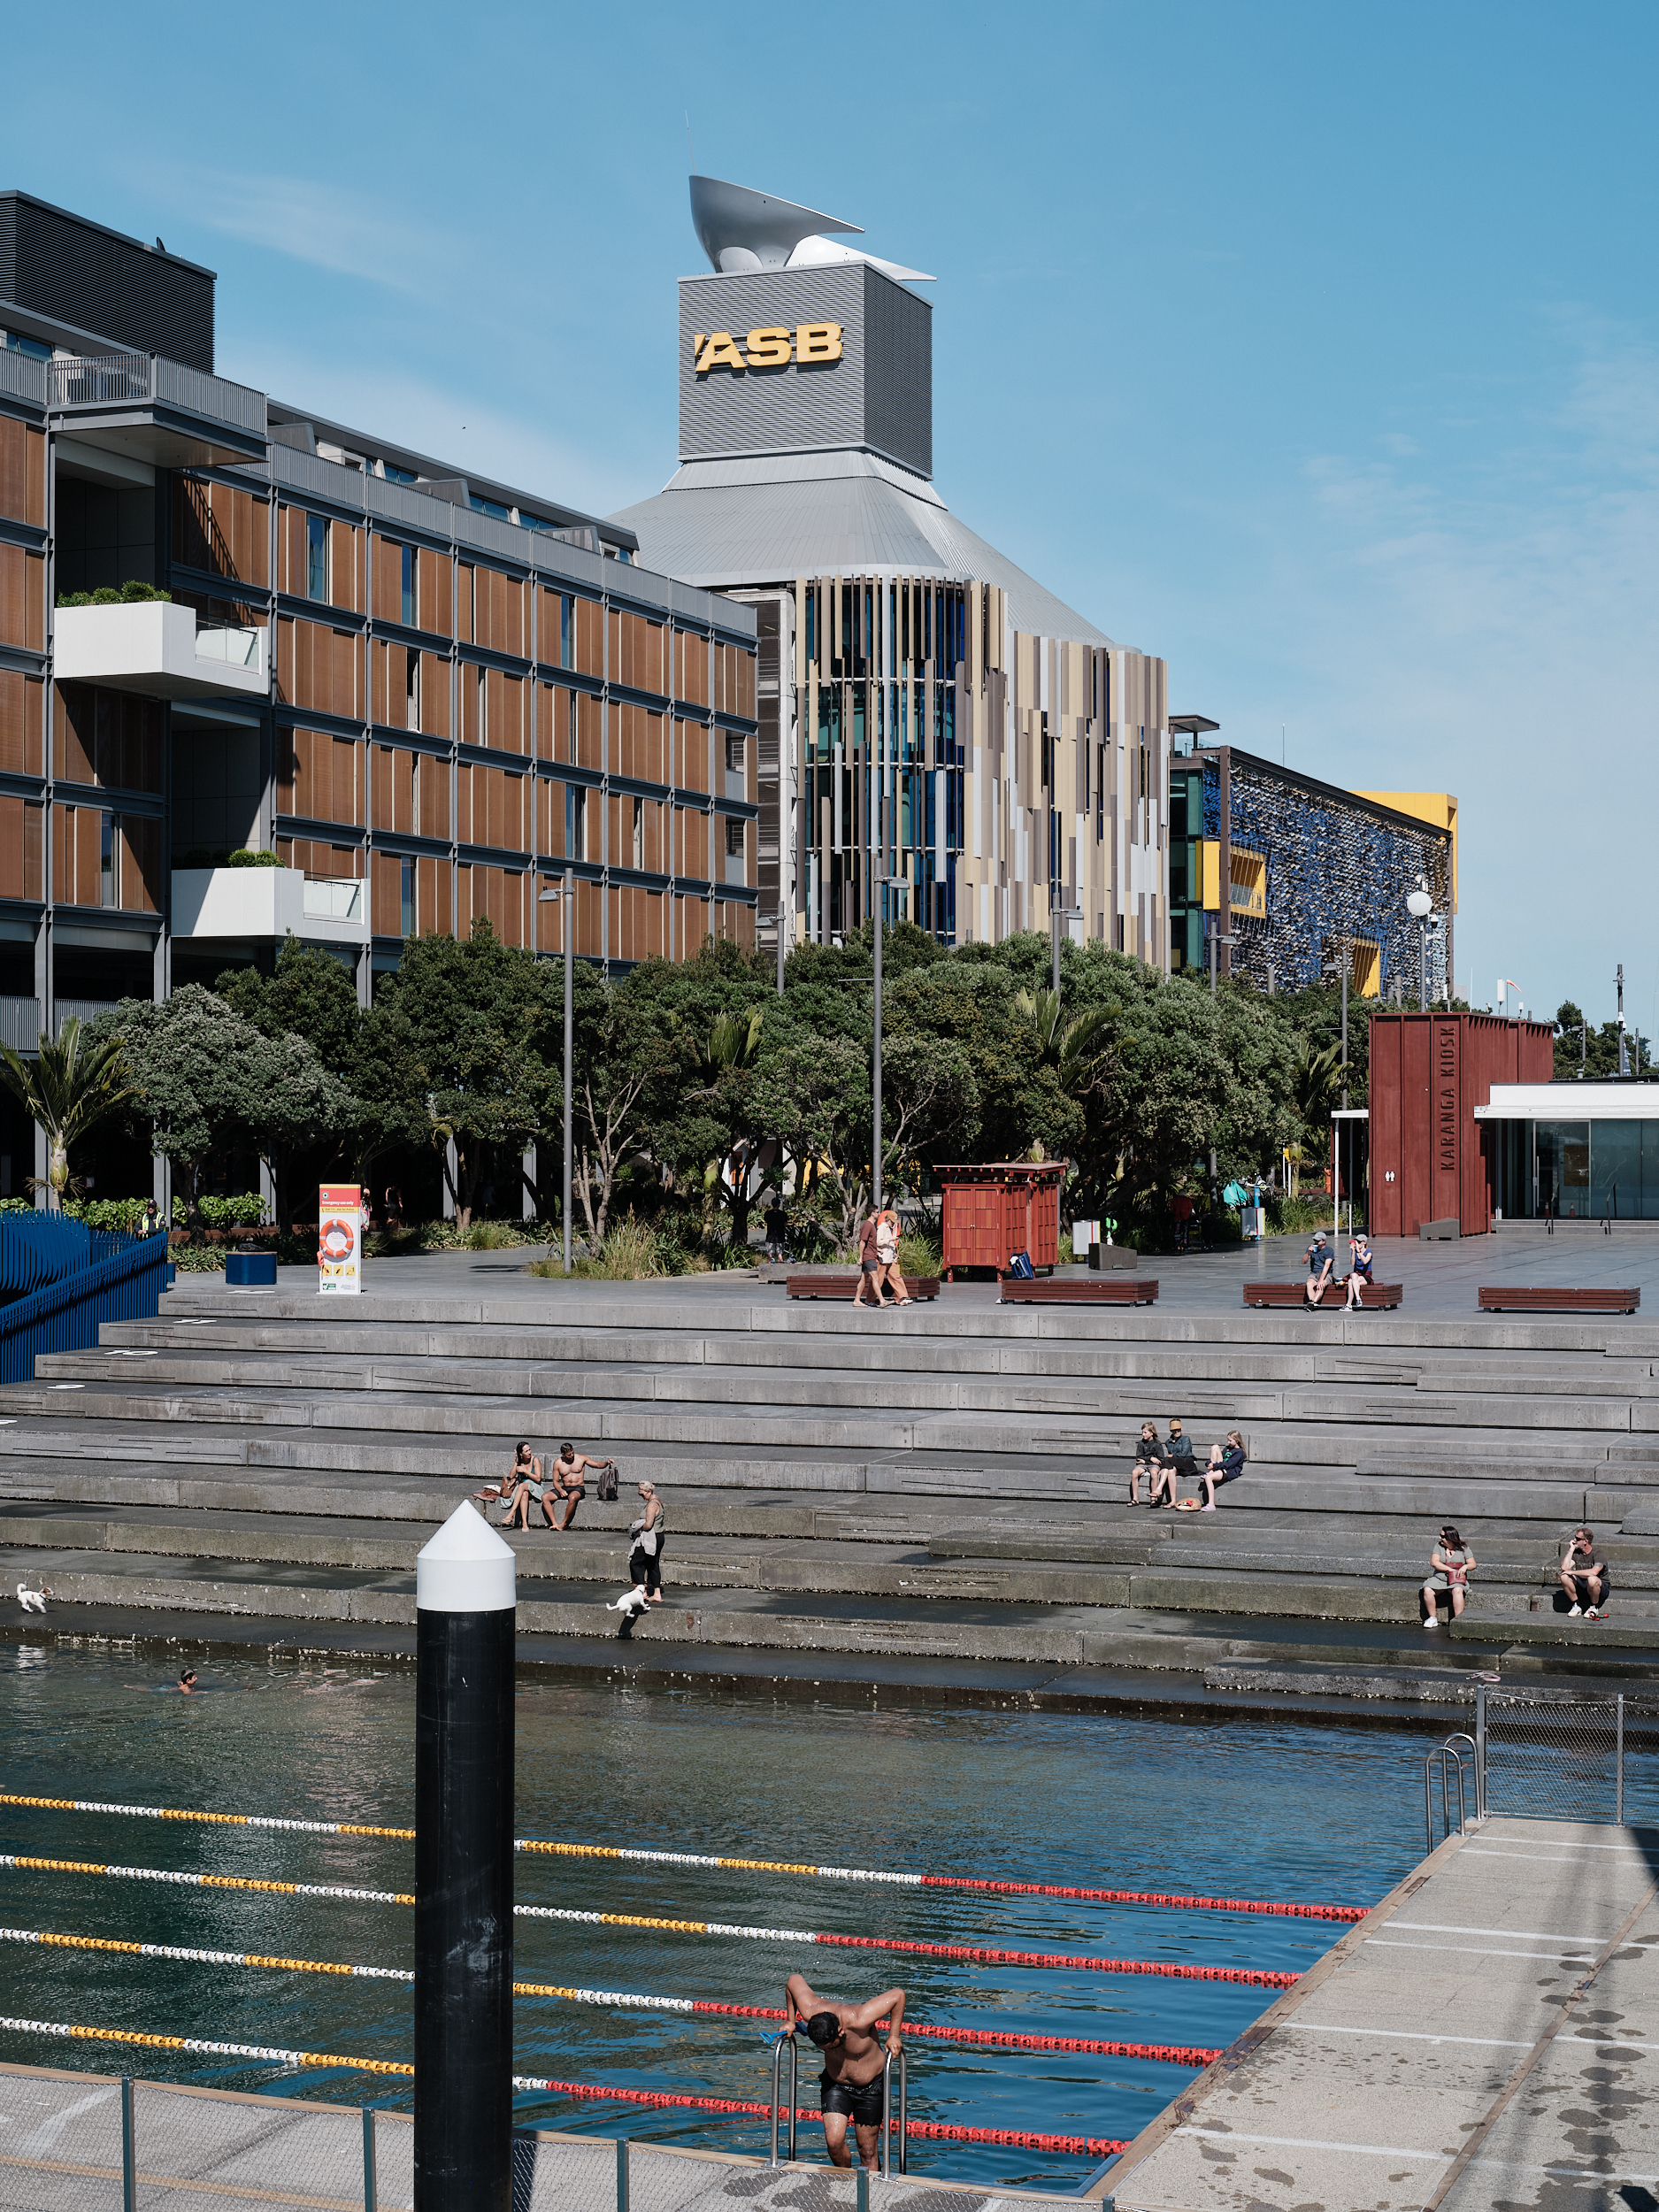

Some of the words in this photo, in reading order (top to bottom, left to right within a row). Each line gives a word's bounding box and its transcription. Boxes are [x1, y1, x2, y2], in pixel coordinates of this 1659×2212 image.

[695, 322, 842, 372] ASB
[1440, 1026, 1455, 1077] KIOSK
[1440, 1087, 1455, 1170] KARANGA
